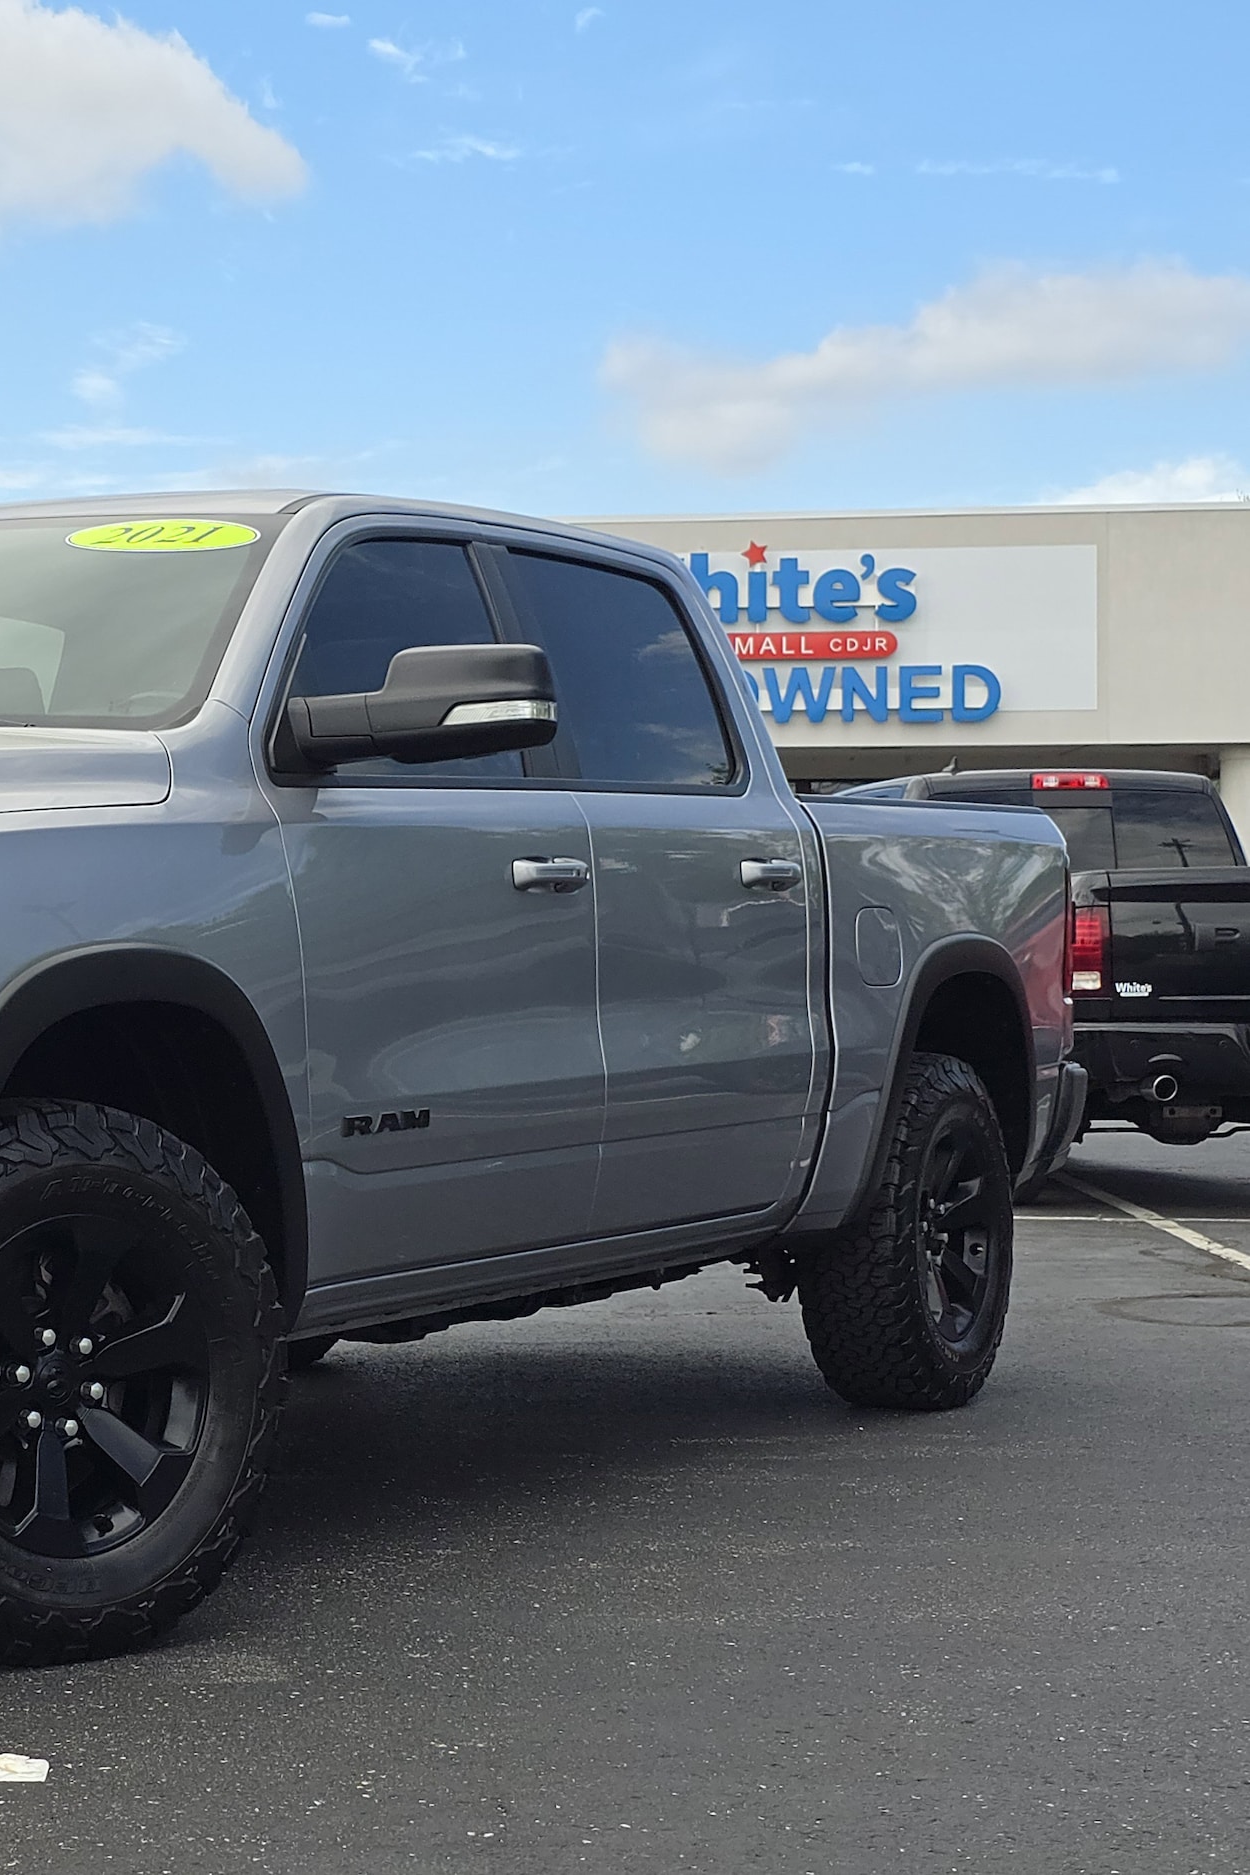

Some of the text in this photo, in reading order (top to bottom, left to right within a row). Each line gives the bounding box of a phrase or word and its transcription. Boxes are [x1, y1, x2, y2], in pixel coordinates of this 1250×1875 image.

[91, 526, 224, 544] 2021
[681, 541, 918, 625] hite's
[734, 636, 888, 655] MALL CDJR
[744, 664, 1002, 724] WNED
[341, 1107, 430, 1138] RAM
